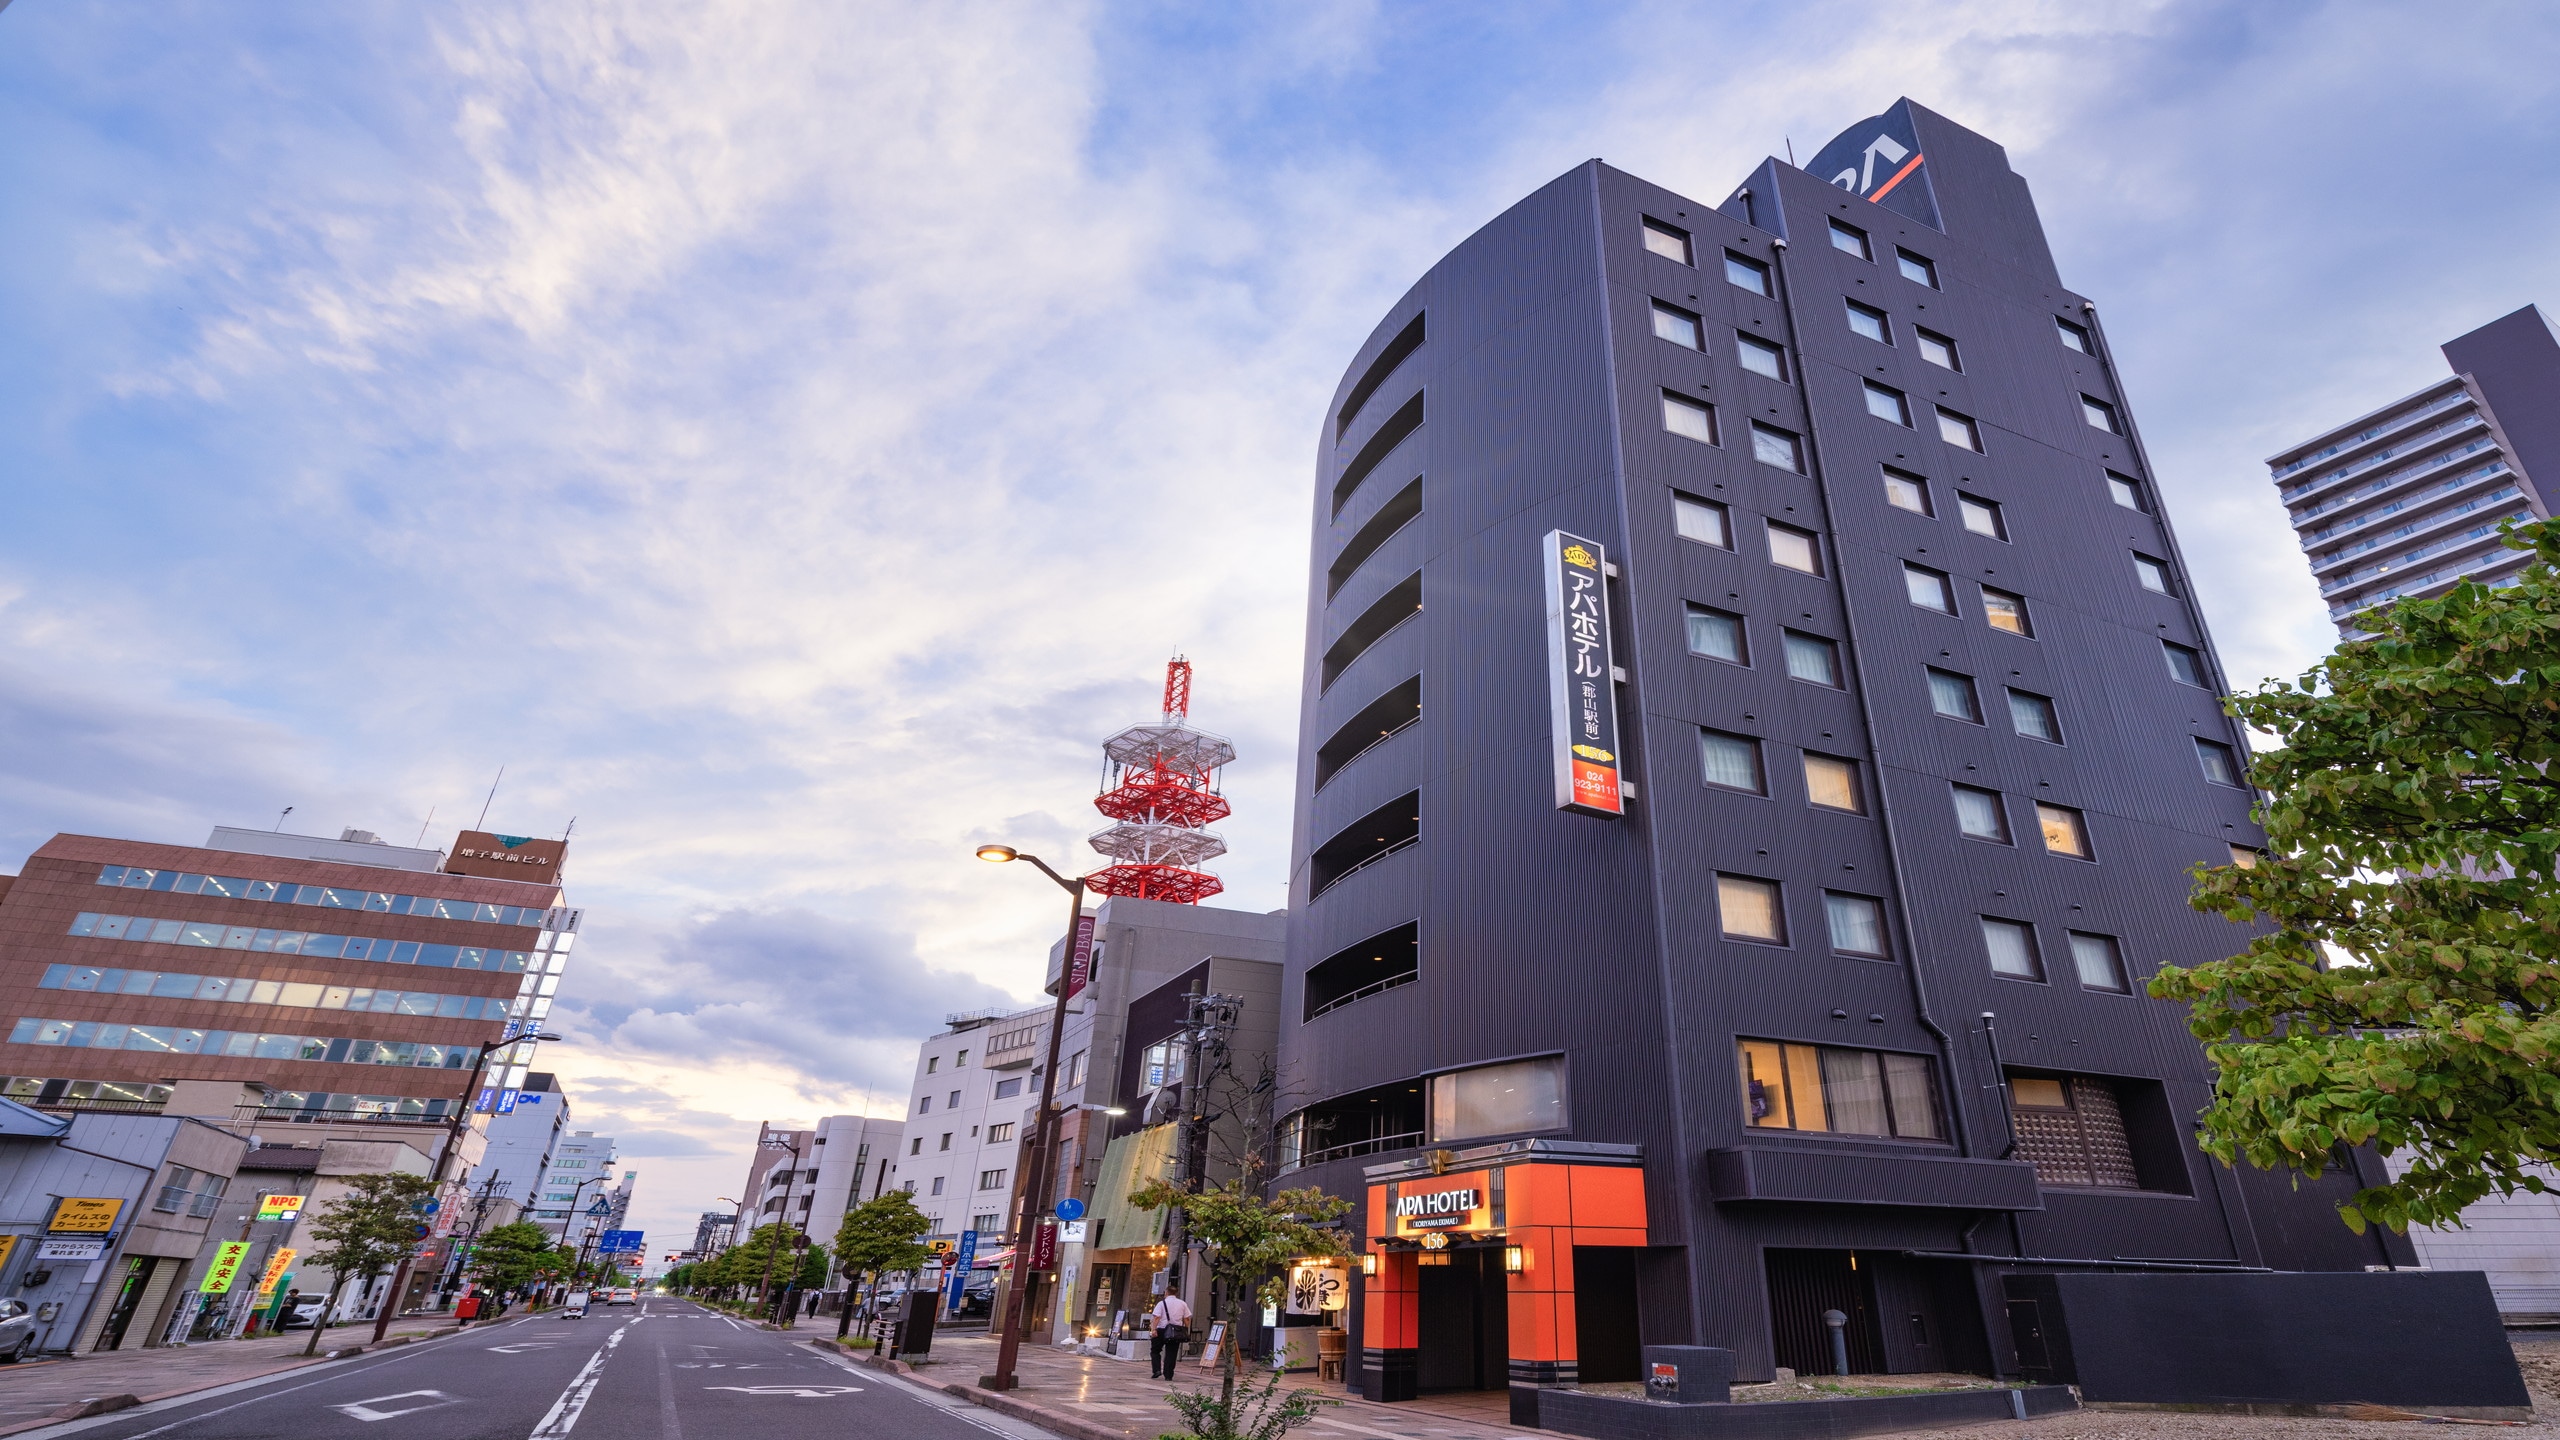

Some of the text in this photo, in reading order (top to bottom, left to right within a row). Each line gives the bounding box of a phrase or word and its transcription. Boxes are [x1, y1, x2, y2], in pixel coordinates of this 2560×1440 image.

[1569, 570, 1602, 678] アパホテル
[1586, 770, 1604, 783] 024
[1574, 777, 1617, 796] 923-9111
[460, 848, 549, 865] 増子駅前ビル
[1076, 922, 1092, 948] BAD
[75, 1200, 106, 1208] Times
[269, 1196, 298, 1207] NPC
[1396, 1189, 1478, 1216] APA HOTEL
[936, 1242, 947, 1252] P
[1039, 1226, 1052, 1268] シンドバット
[1426, 1232, 1444, 1249] 156
[959, 1240, 974, 1271] 東日本学院
[208, 1244, 242, 1291] 交通安全
